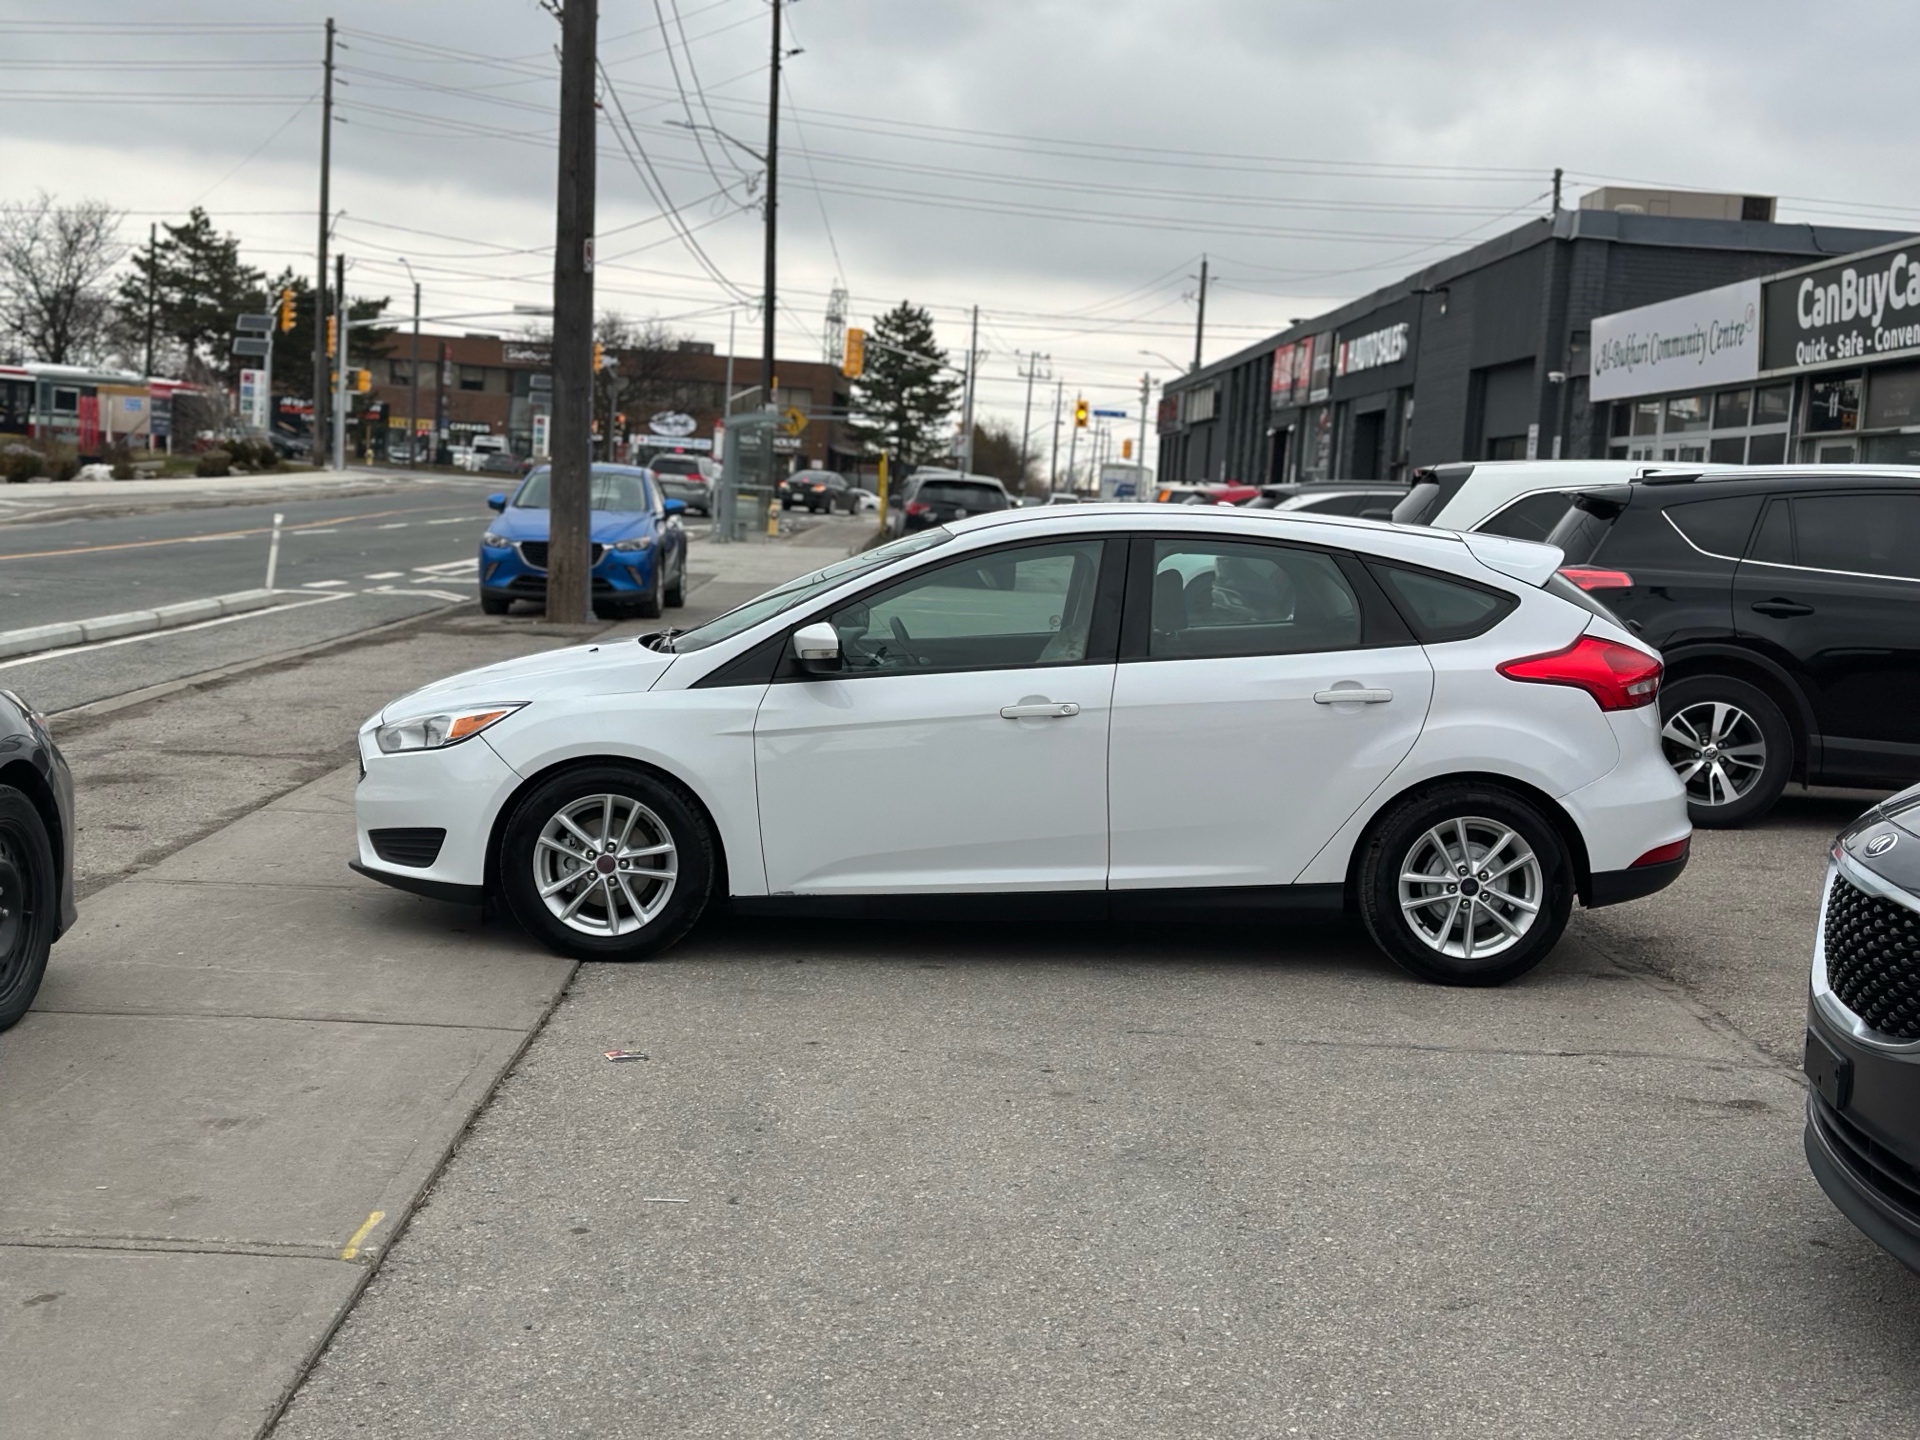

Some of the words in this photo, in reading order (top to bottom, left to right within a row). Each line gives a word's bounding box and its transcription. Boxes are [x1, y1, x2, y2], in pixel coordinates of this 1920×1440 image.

[1797, 252, 1920, 329] CanBuyCa
[1650, 322, 1708, 366] Community
[1709, 319, 1745, 356] Centre
[1796, 336, 1828, 367] Quick
[1837, 329, 1864, 359] Safe
[1874, 323, 1920, 352] Conven
